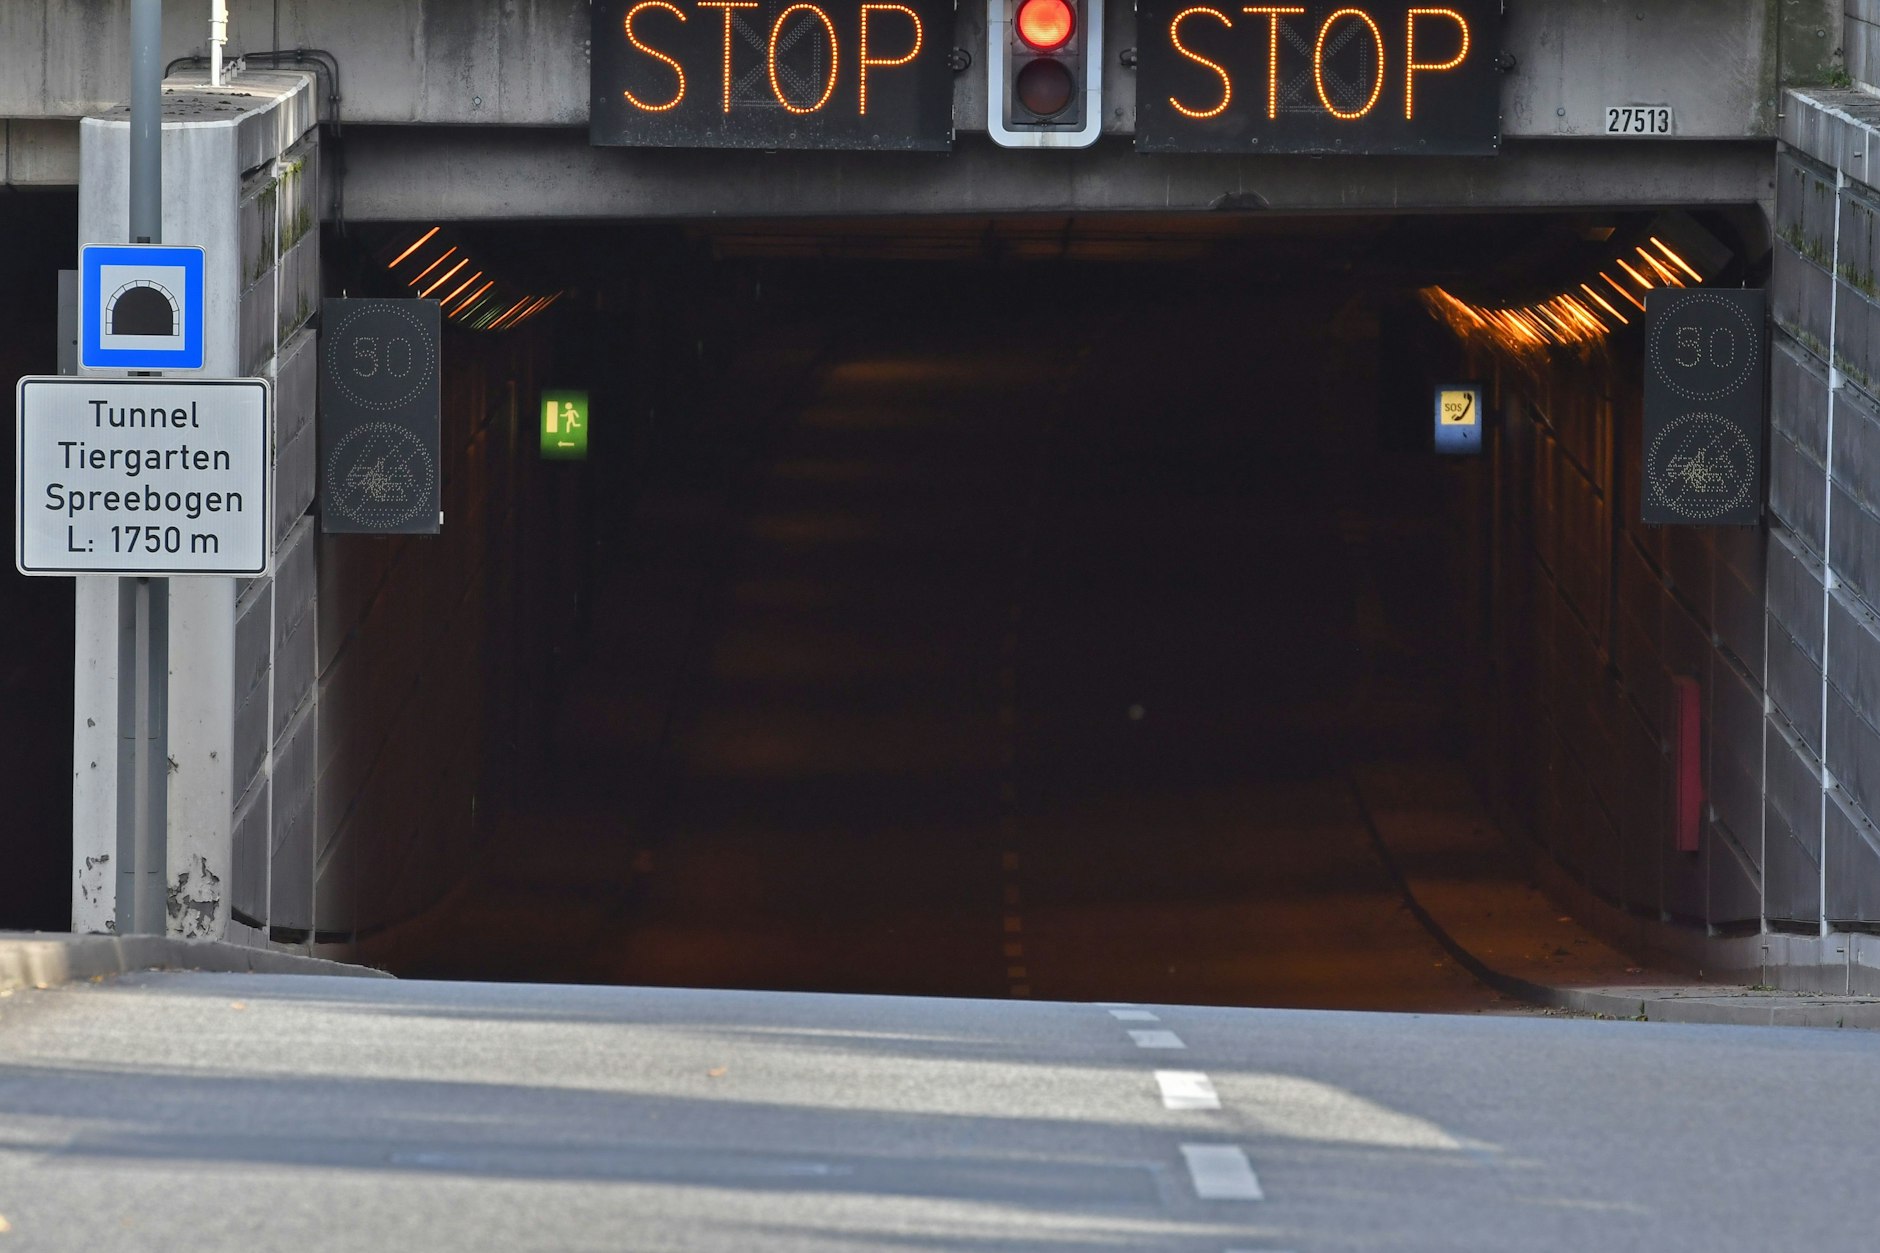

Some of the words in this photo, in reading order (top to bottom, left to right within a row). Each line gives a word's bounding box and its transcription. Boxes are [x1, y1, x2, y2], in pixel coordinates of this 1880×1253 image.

[624, 1, 923, 115] STOP
[1169, 6, 1470, 120] STOP
[1608, 108, 1669, 133] 27513
[88, 400, 200, 429] Tunnel
[1444, 402, 1463, 412] SOS
[57, 441, 231, 477] Tiergarten
[45, 482, 243, 519] Spreebogen
[68, 525, 94, 553] L:
[111, 525, 181, 554] 1750
[191, 532, 219, 554] m
